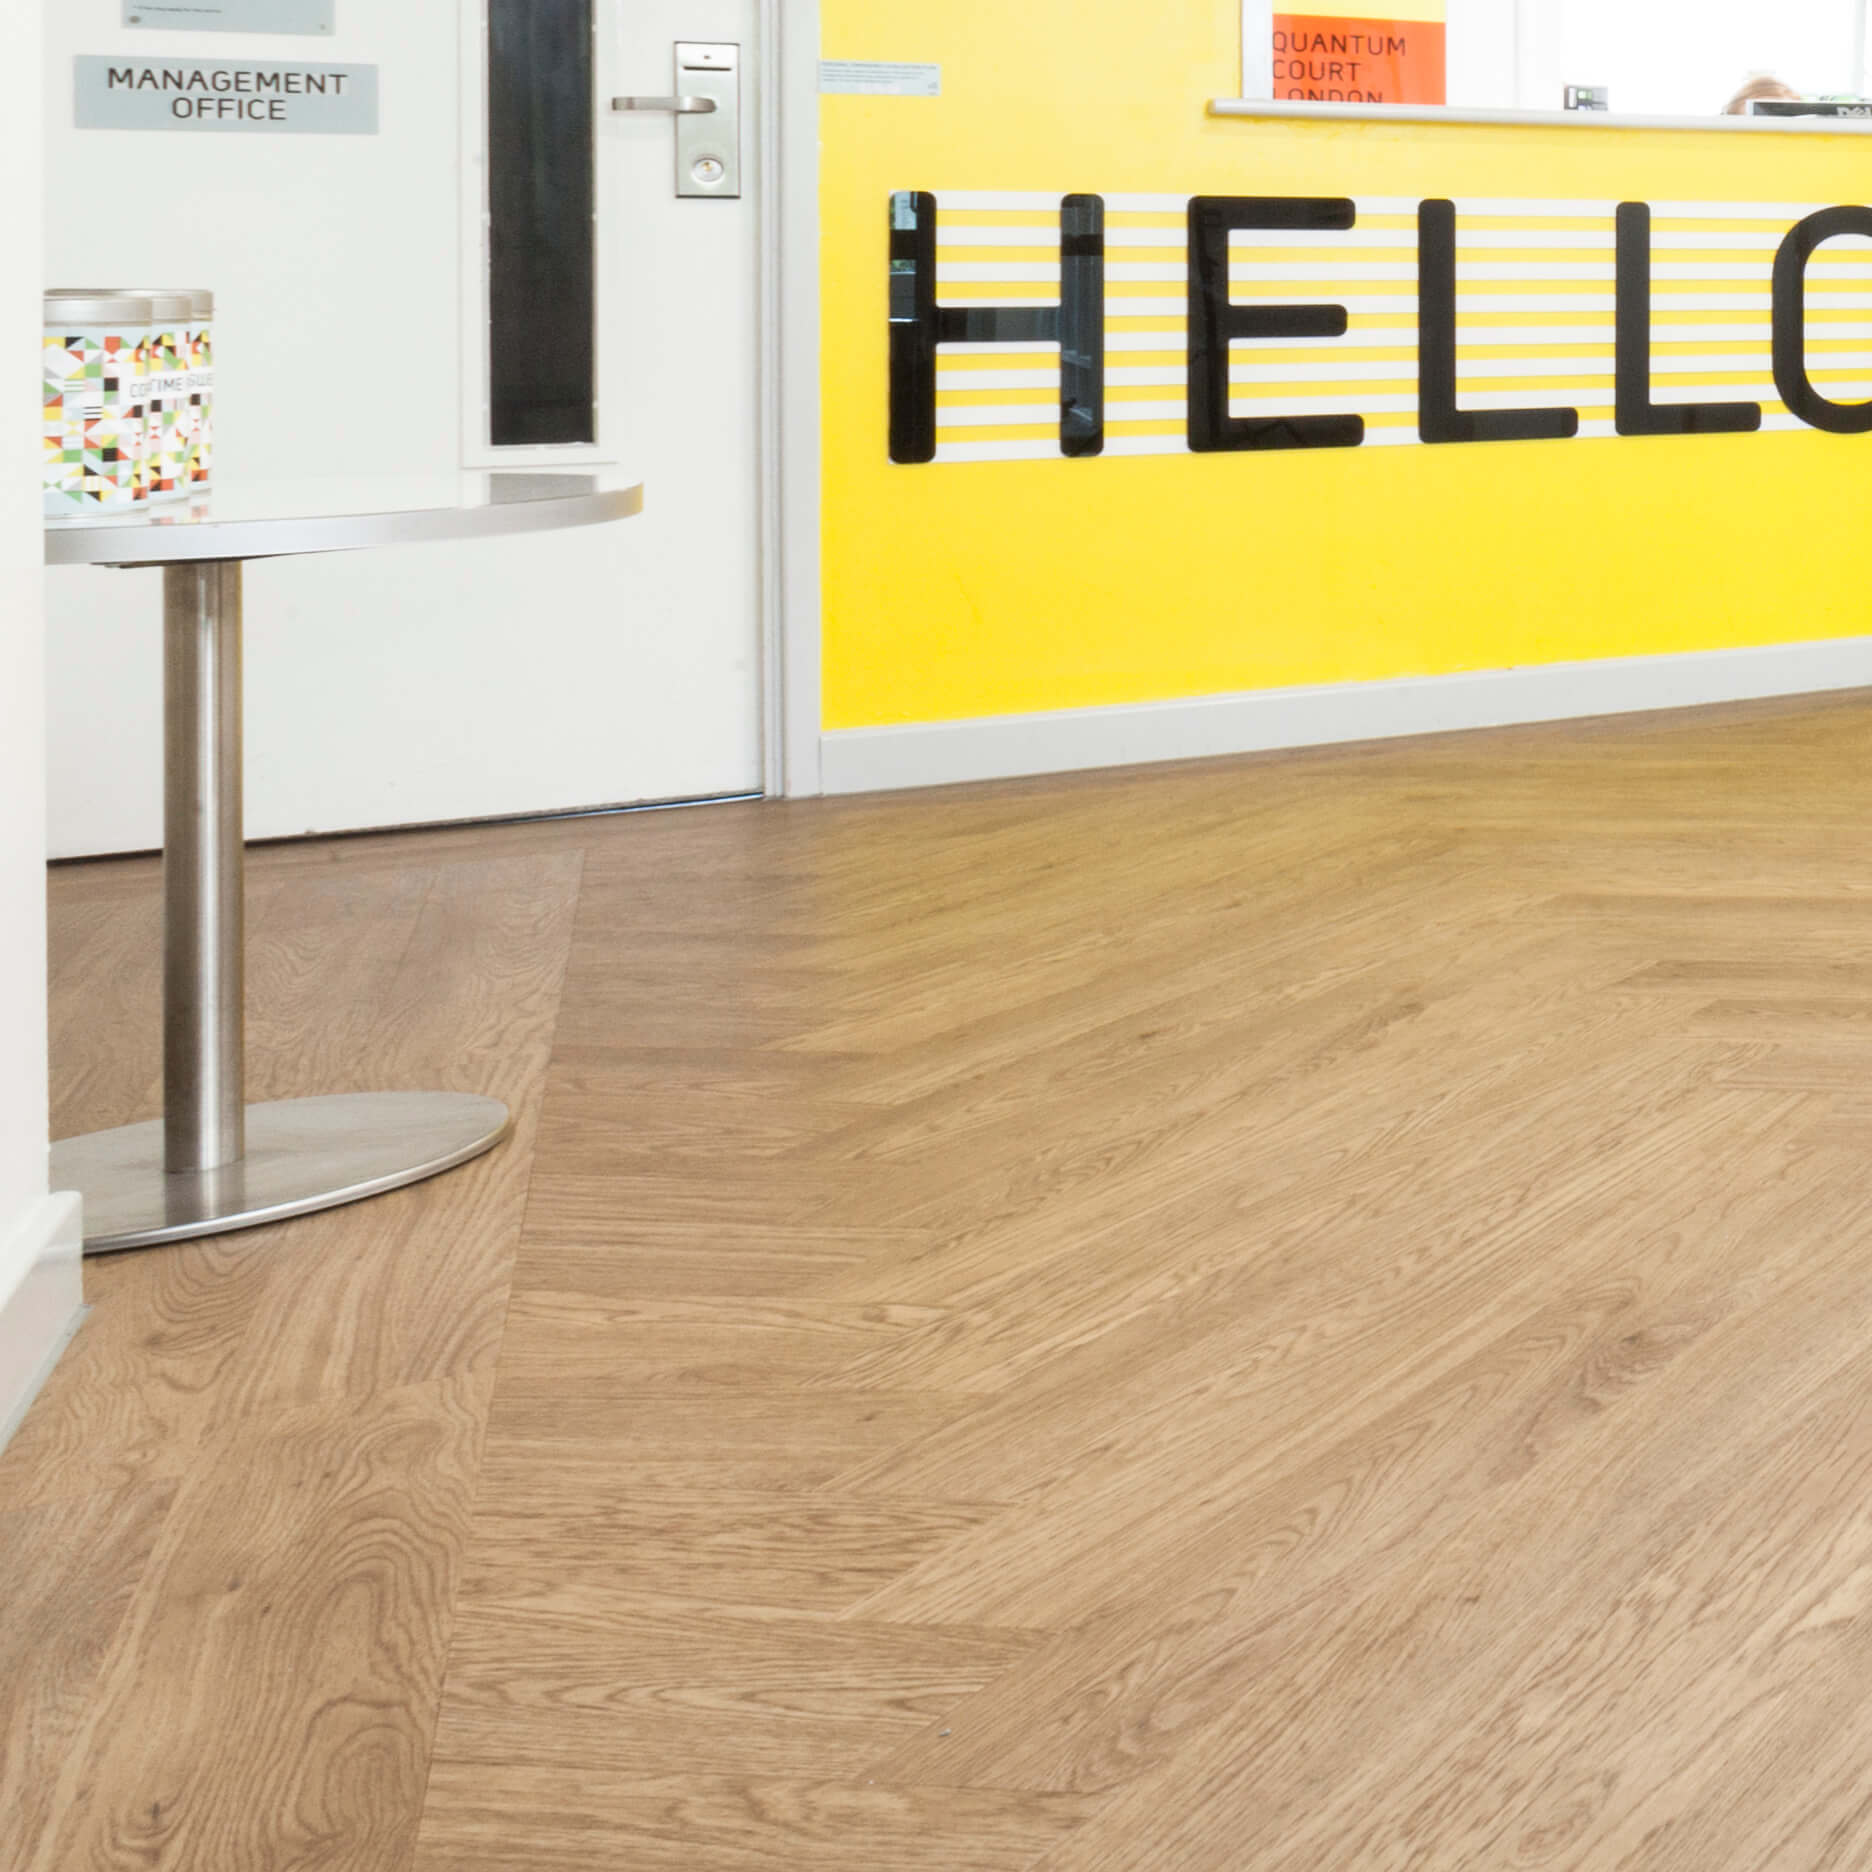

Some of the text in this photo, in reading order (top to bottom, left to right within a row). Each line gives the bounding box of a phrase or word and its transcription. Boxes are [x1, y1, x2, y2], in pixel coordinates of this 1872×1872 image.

[1273, 31, 1406, 57] QUANTUM
[107, 67, 348, 95] MANAGEMENT
[1273, 59, 1361, 82] COURT
[171, 97, 288, 120] OFFICE
